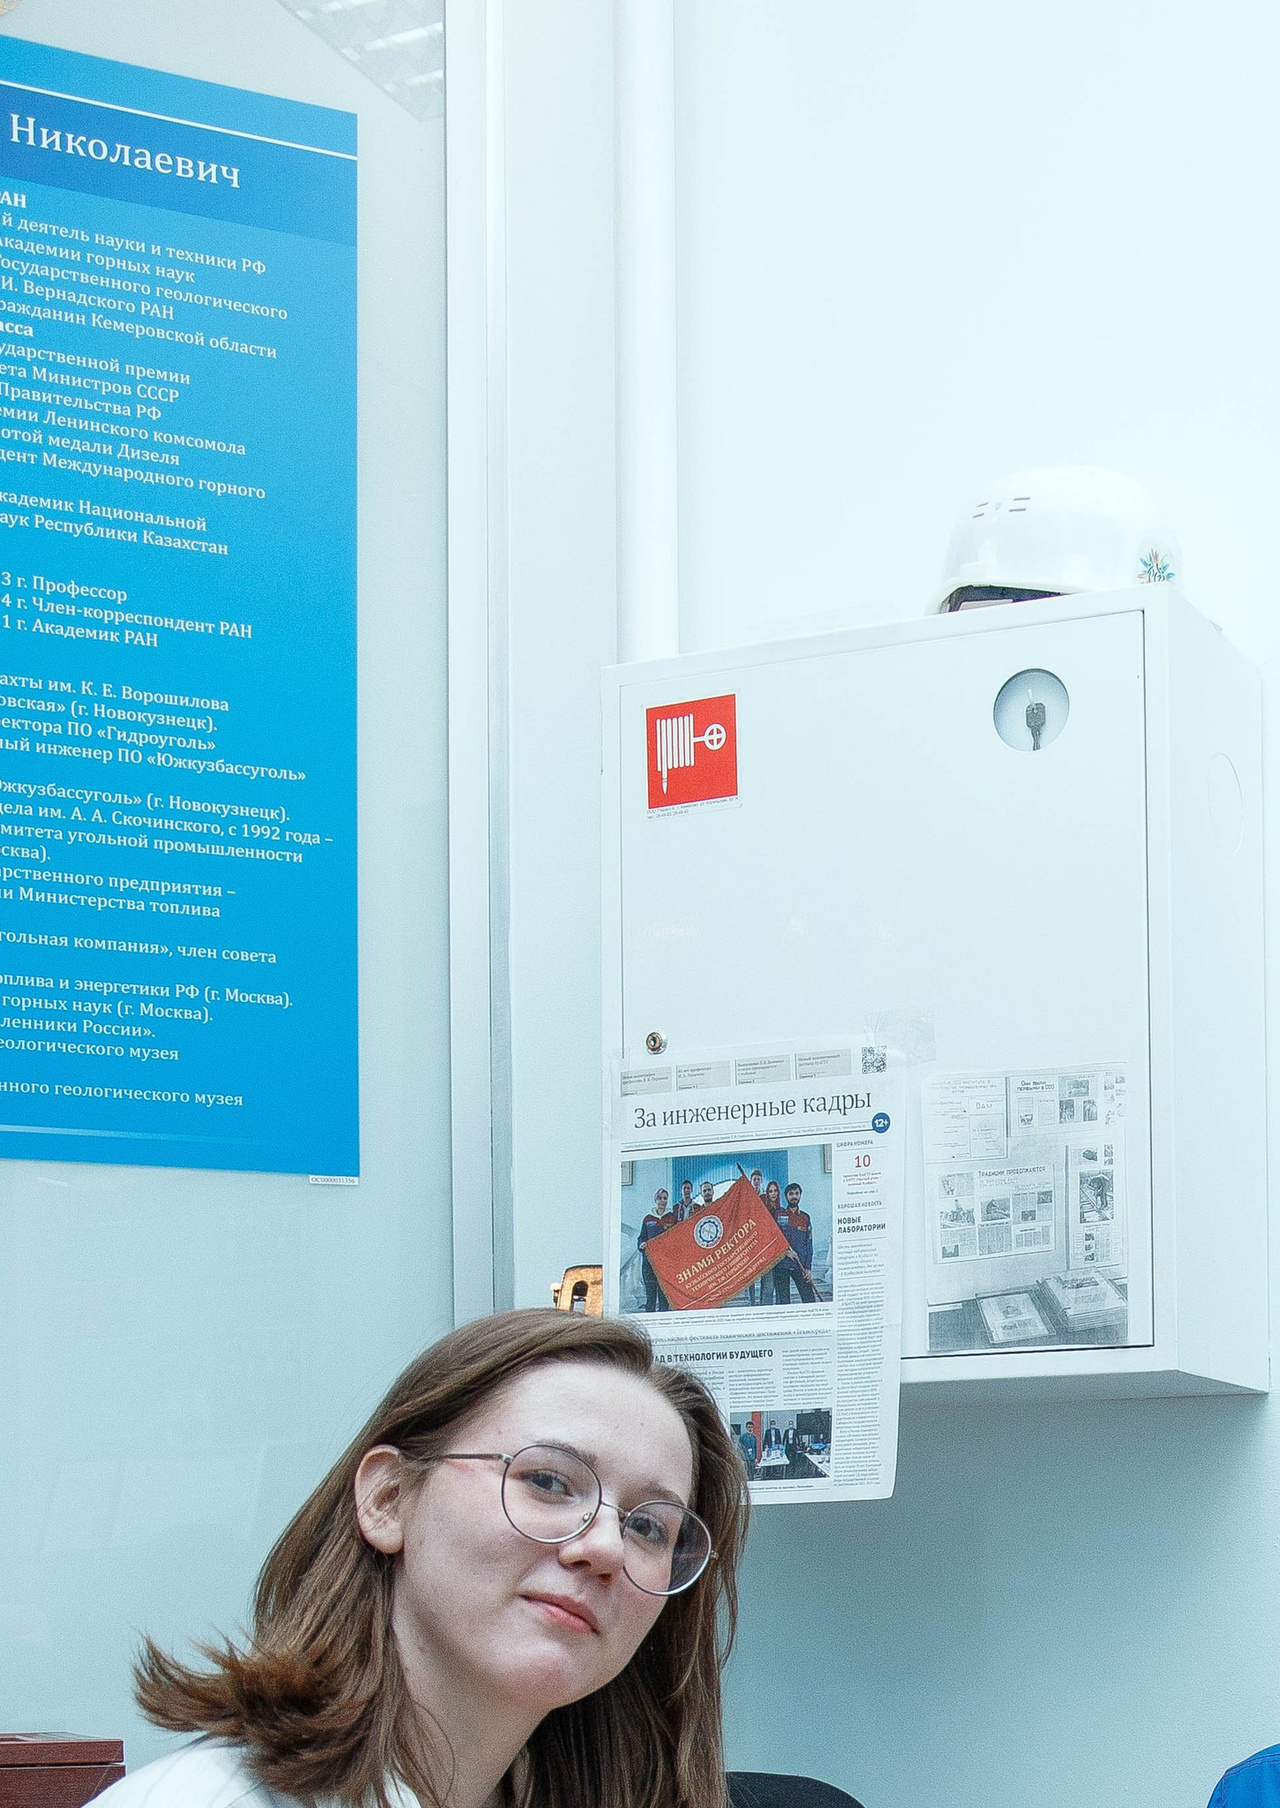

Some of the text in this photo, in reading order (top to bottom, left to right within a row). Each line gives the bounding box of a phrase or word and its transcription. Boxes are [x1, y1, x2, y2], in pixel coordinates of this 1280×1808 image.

[9, 112, 241, 189] Николаевич
[16, 218, 267, 276] деятель науки техники РФ
[85, 252, 152, 275] горных
[155, 265, 196, 284] наук
[0, 253, 288, 320] осударственного геологического
[23, 279, 174, 321] Вернадского РАН
[91, 312, 205, 347] Кемеровской
[208, 336, 277, 359] области
[32, 365, 132, 396] Министров
[136, 383, 180, 403] СССР
[124, 363, 191, 385] премии
[136, 403, 162, 421] РФ
[42, 409, 149, 440] Ленинского
[152, 430, 247, 456] комсомола
[47, 434, 113, 456] медали
[116, 442, 180, 466] Дизеля
[41, 451, 195, 489] Международного
[198, 479, 266, 500] горного
[77, 498, 207, 532] Национальной
[33, 513, 138, 543] Республики
[142, 529, 229, 556] Казахстан
[32, 574, 128, 606] Профессор
[31, 596, 253, 640] Член-корреспондент РАН
[31, 617, 159, 649] Академик РАН
[47, 679, 77, 694] им.
[120, 684, 231, 712] Ворошилова
[93, 702, 218, 734] Новокузнецк).
[66, 720, 93, 738] ПО
[96, 724, 217, 751] «Гидроуголь»
[35, 741, 114, 765] инженер
[117, 747, 143, 764] ПО
[146, 751, 307, 781] «Южкузбассуголь»
[0, 778, 291, 825] жкузбассуголь» Новокузнецк).
[37, 805, 67, 820] им.
[111, 810, 225, 837] Скочинского,
[241, 823, 281, 841] 1992
[284, 830, 322, 847] года
[66, 830, 149, 849] угольной
[153, 838, 304, 864] промышленности
[0, 866, 223, 898] рственного предприятия
[18, 885, 221, 918] Министерства топлива
[73, 936, 174, 958] компания»,
[176, 945, 218, 960] член
[221, 949, 277, 964] совета
[1, 995, 214, 1025] горных наук Москва).
[73, 979, 171, 998] энергетики
[174, 983, 200, 999] РФ
[224, 987, 294, 1010] Москва).
[82, 1018, 156, 1038] России».
[129, 1046, 179, 1063] музея
[54, 1084, 191, 1103] геологического
[194, 1092, 244, 1108] музея
[633, 1092, 873, 1129] За инженерные кадры
[874, 1118, 889, 1128] 12+
[854, 1154, 871, 1169] 10
[837, 1216, 862, 1225] НОВЫЕ
[837, 1223, 886, 1235] ЛАБОРАТОРИИ
[676, 1254, 716, 1285] ЗНАМЯ
[714, 1218, 757, 1260] РЕКТОРА
[674, 1351, 728, 1363] ТЕХНОЛОГИИ
[729, 1349, 774, 1361] БУДУЩЕГО
